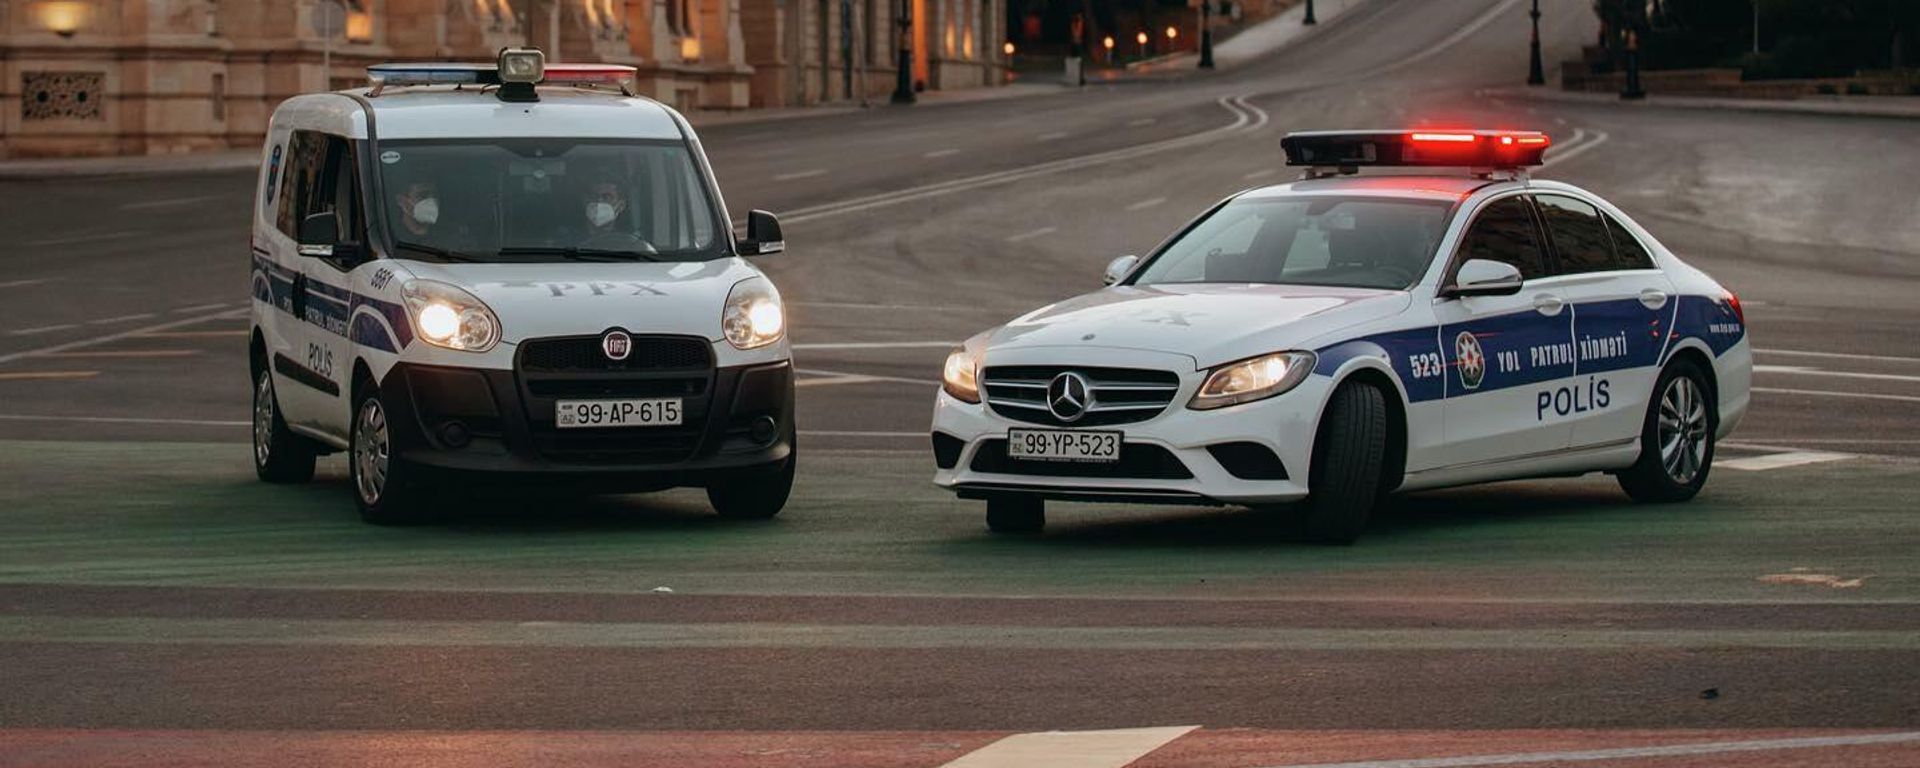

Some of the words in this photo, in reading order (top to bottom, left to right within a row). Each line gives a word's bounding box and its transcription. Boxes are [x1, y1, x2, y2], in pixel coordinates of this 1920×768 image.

[545, 282, 669, 297] PPX
[609, 339, 625, 353] FIAT
[1497, 350, 1520, 373] YOL
[1531, 342, 1573, 368] PATRUL
[308, 342, 333, 377] POLİS
[1409, 352, 1441, 378] 523
[1537, 375, 1610, 421] POLİS
[577, 401, 677, 424] 99-AP-615
[1025, 433, 1115, 456] 99-YP-523
